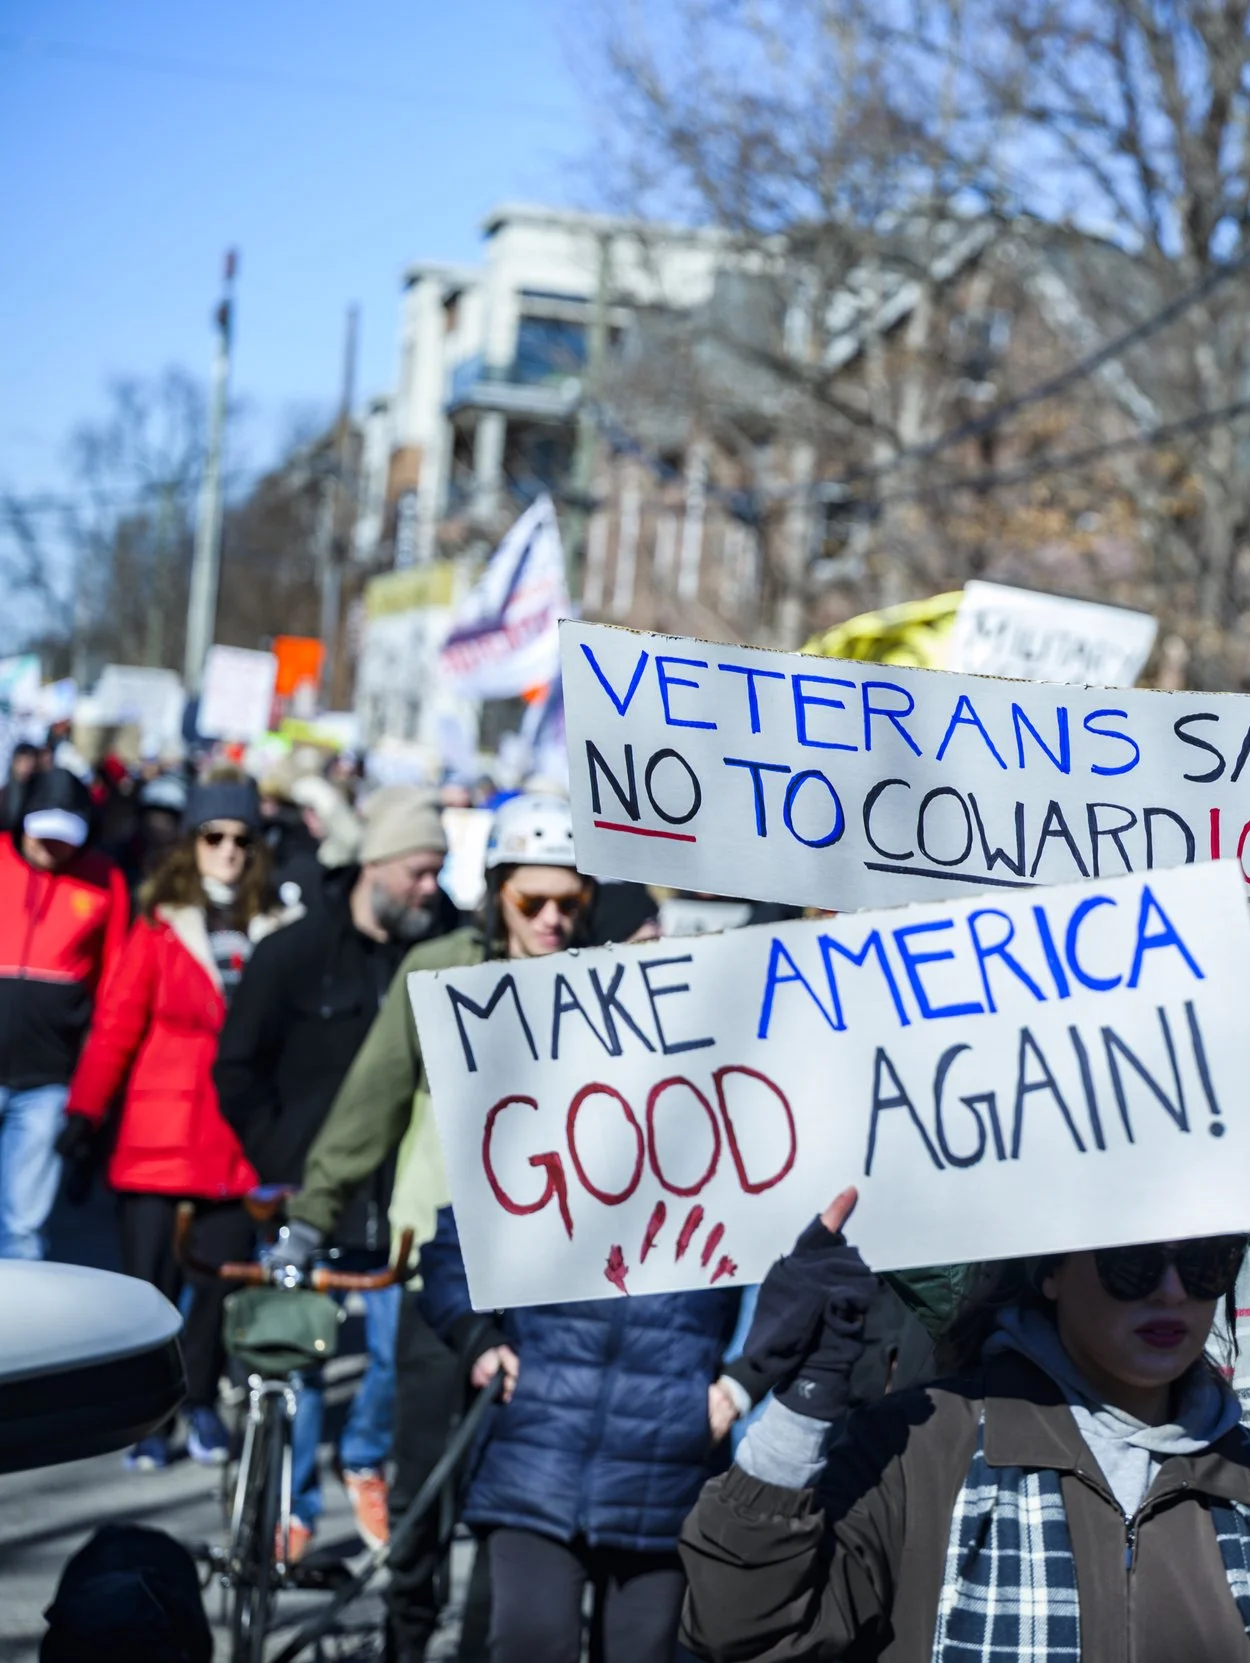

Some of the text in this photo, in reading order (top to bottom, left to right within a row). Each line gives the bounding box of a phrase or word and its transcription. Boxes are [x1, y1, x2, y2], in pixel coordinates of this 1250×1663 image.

[579, 642, 1140, 776] VETERANS
[585, 739, 702, 825] NO
[723, 756, 845, 849] TO
[446, 884, 1206, 1072] MAKE AMERICA
[481, 1000, 1226, 1241] GOOD AGAIN!
